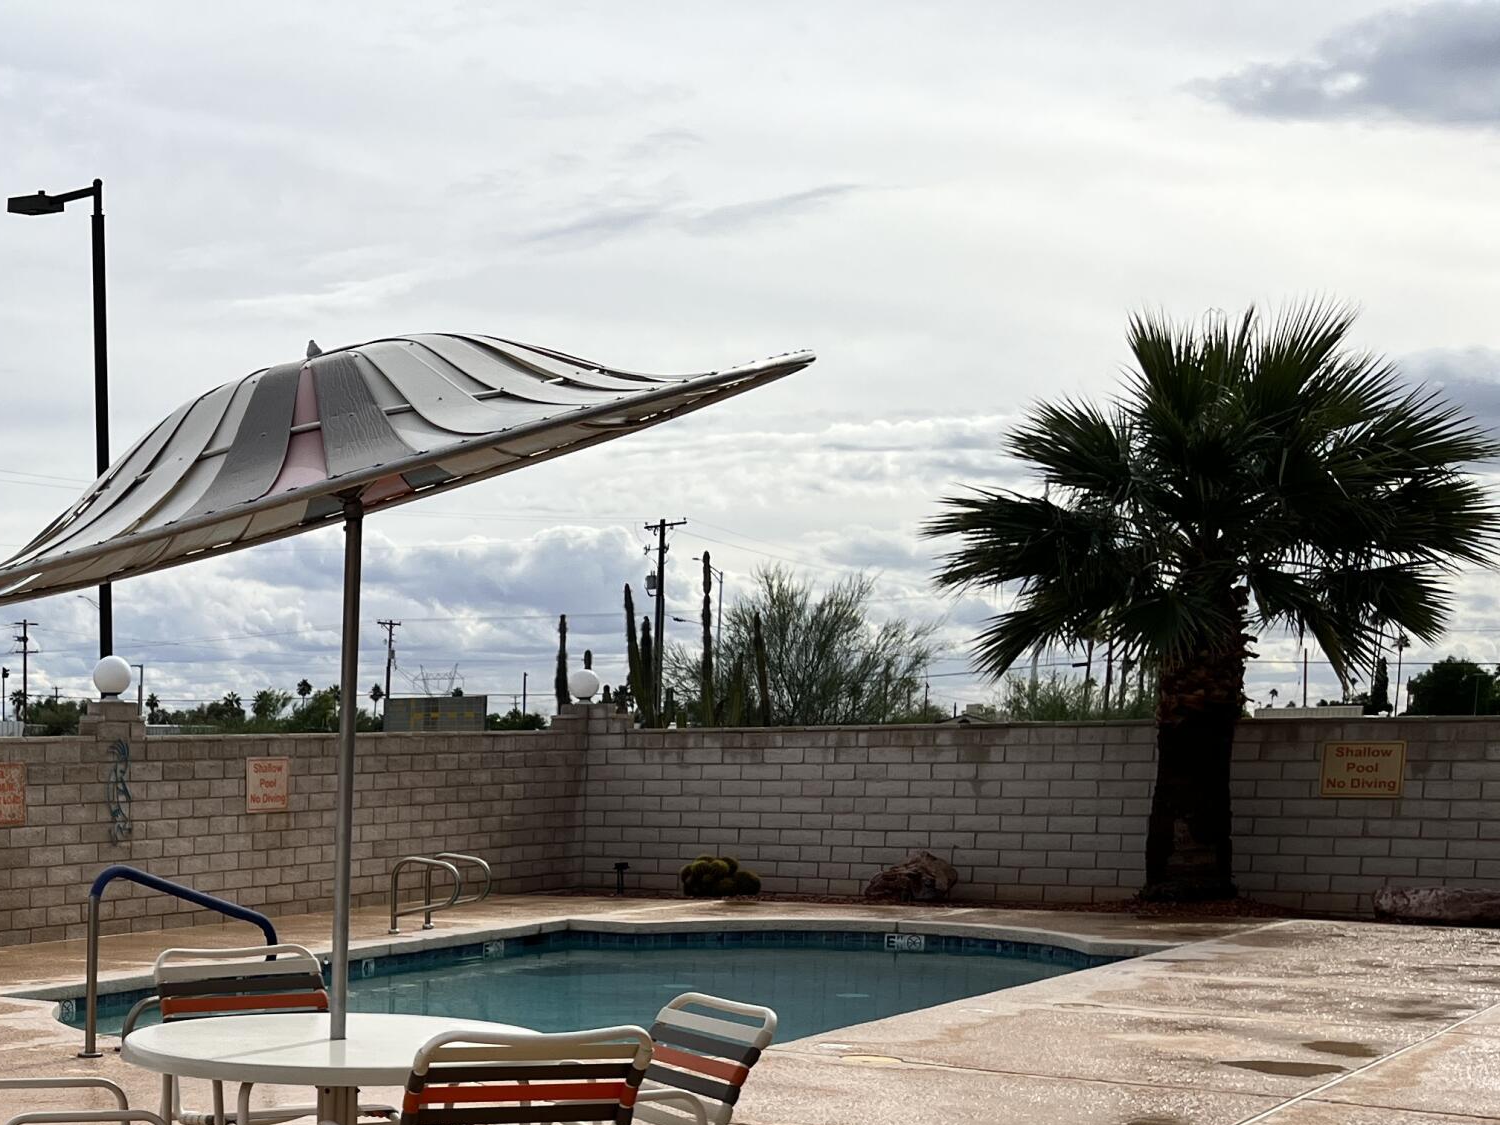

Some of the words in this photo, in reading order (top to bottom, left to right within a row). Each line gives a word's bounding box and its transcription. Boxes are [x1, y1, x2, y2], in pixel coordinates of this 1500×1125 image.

[1335, 746, 1393, 757] Shallow
[253, 763, 283, 773] Shallow
[1346, 762, 1379, 773] Pool
[260, 778, 276, 788] Pool
[1326, 778, 1346, 788] No
[1350, 778, 1397, 791] Diving
[250, 794, 260, 803] No
[263, 793, 285, 805] Diving
